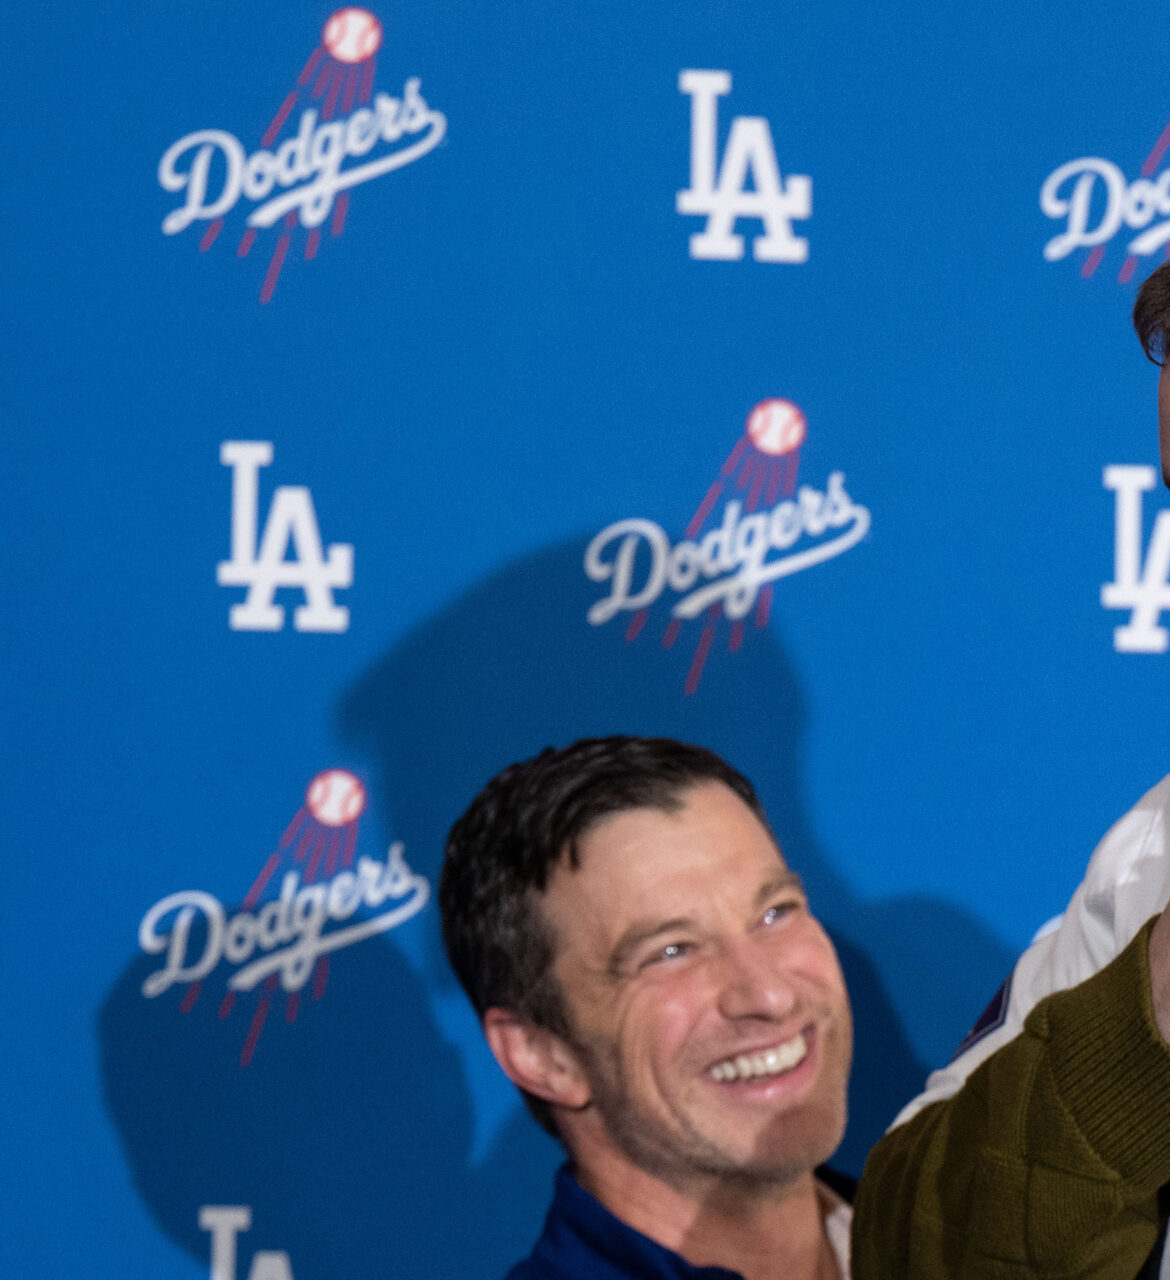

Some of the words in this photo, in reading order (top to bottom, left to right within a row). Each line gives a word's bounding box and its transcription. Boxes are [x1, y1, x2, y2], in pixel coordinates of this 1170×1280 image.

[159, 79, 447, 235] Dodgers
[678, 70, 811, 263] LA
[218, 441, 353, 632] LA
[585, 473, 870, 625] Dodgers
[139, 843, 430, 998] Dodgers
